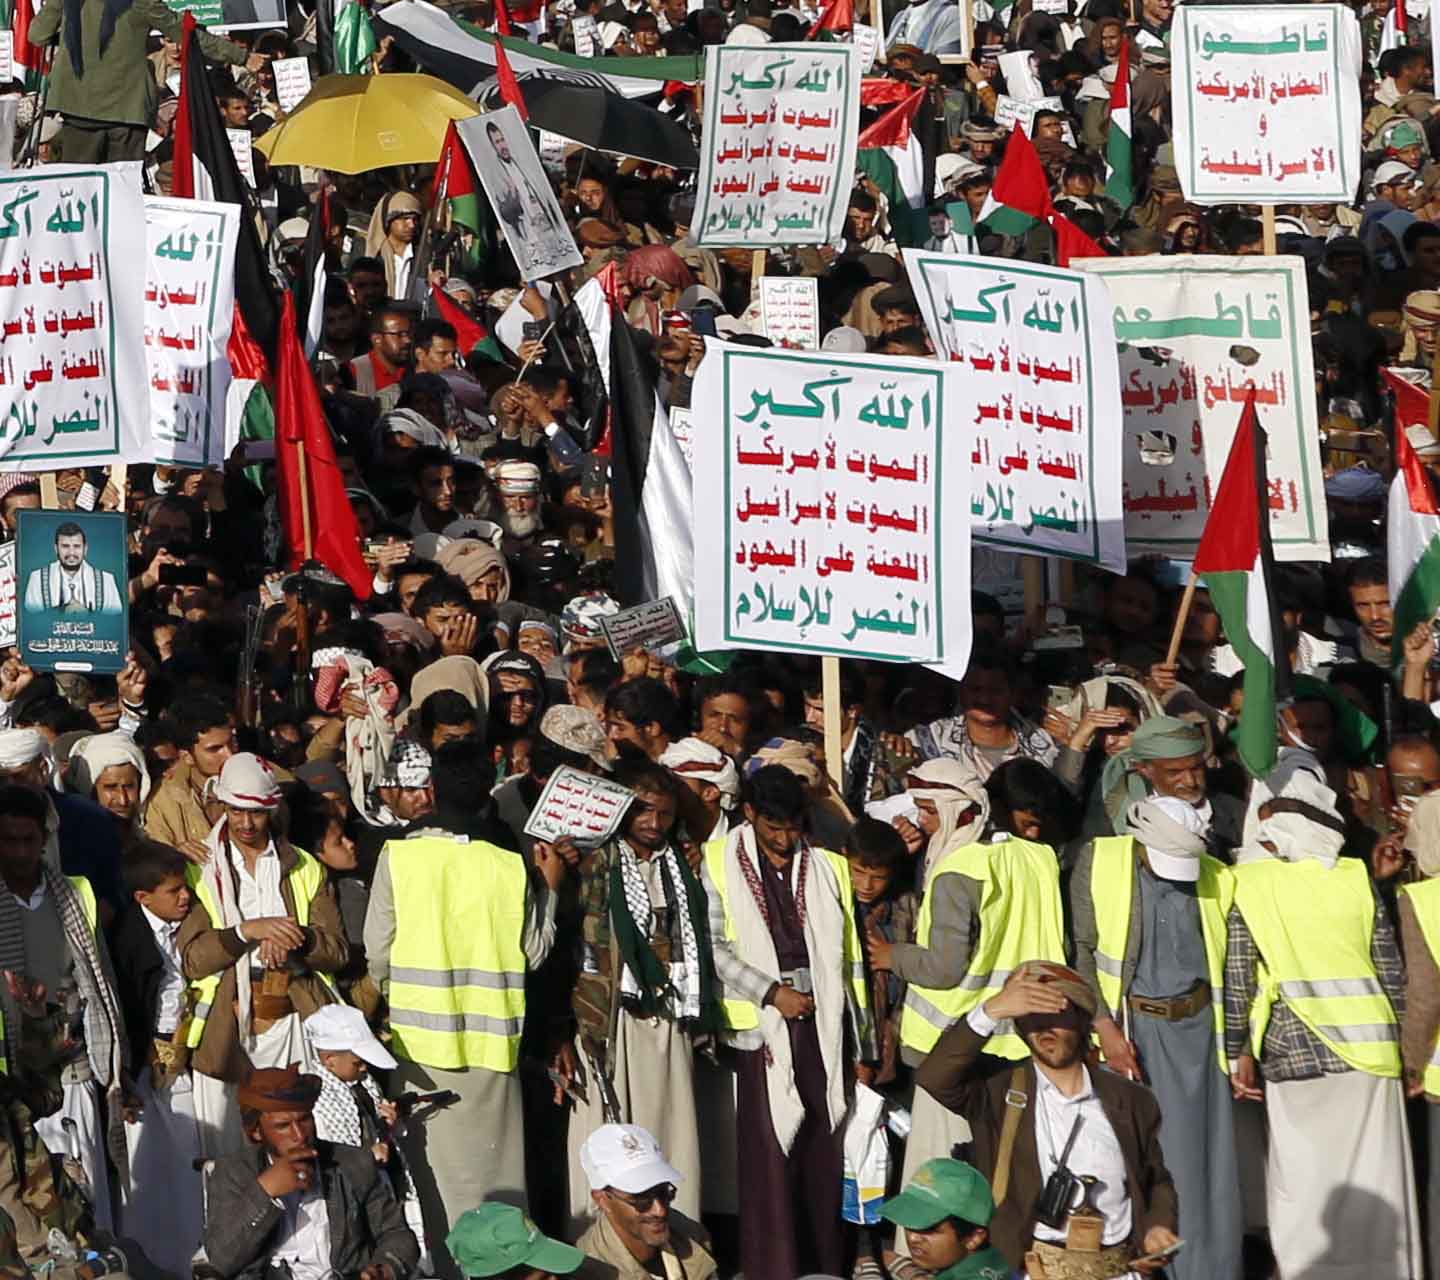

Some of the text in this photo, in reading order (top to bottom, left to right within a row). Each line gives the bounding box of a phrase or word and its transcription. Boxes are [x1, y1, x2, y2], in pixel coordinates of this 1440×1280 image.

[1194, 22, 1327, 60] قاطعوا
[1270, 71, 1328, 104] البضائع
[782, 108, 838, 130] الموت
[1259, 114, 1267, 137] و
[777, 143, 835, 164] الموت
[712, 170, 830, 198] اللعنة على اليهود
[769, 200, 824, 237] النصر
[735, 369, 930, 430] الله أكبر
[736, 434, 928, 484] الموت لأمريكا
[736, 486, 928, 534] الموت لإسرائيل
[735, 538, 928, 584] اللعنة على اليهود
[735, 581, 929, 641] النصر للإسلام
